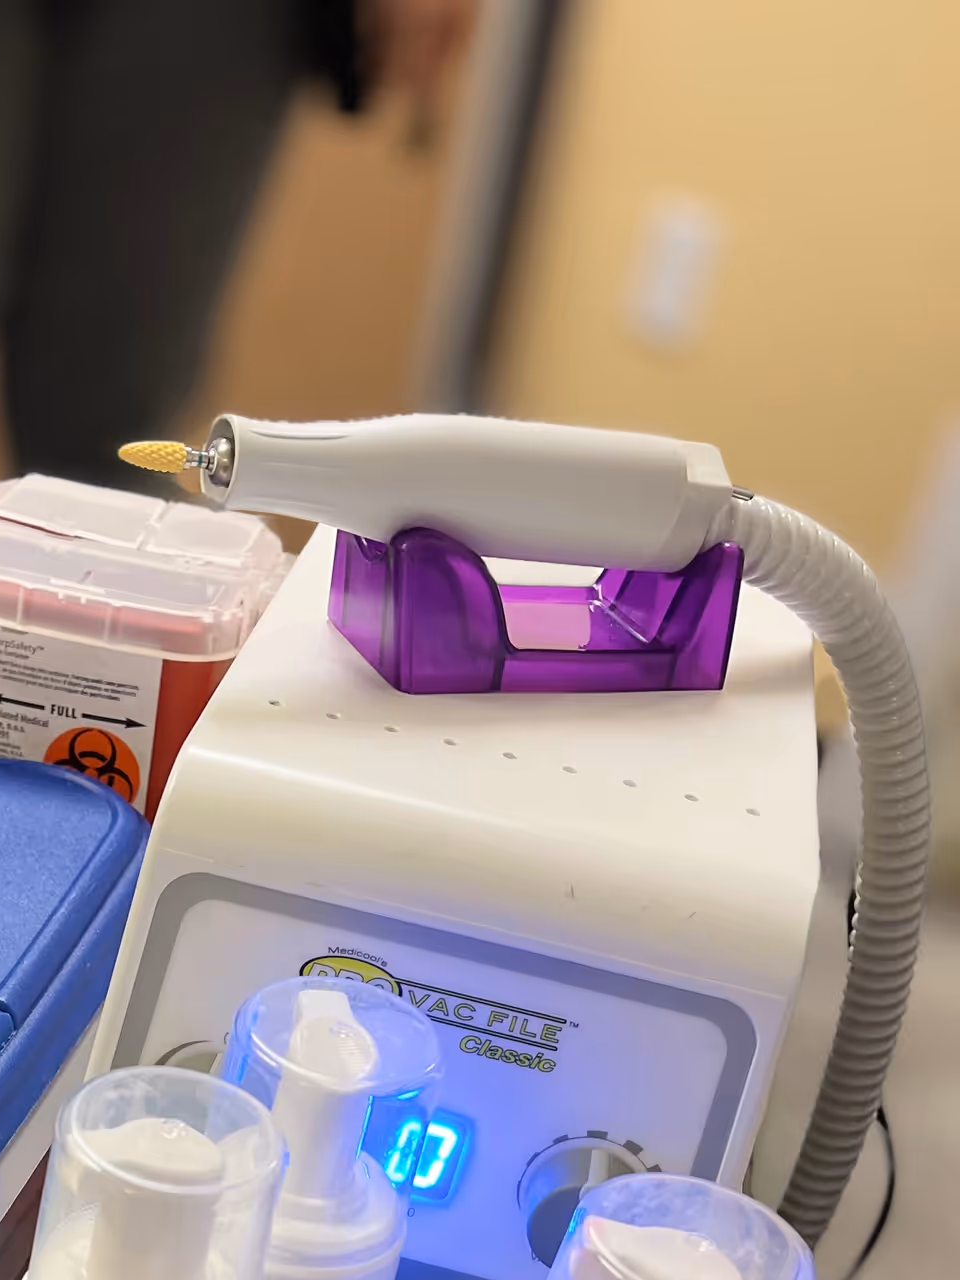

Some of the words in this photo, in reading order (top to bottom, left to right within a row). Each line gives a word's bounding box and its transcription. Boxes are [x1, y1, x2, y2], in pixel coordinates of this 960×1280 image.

[20, 713, 50, 728] Medical
[50, 704, 77, 719] FULL
[328, 946, 388, 968] Medicool's
[408, 990, 477, 1021] VAC
[458, 1034, 557, 1073] Classic
